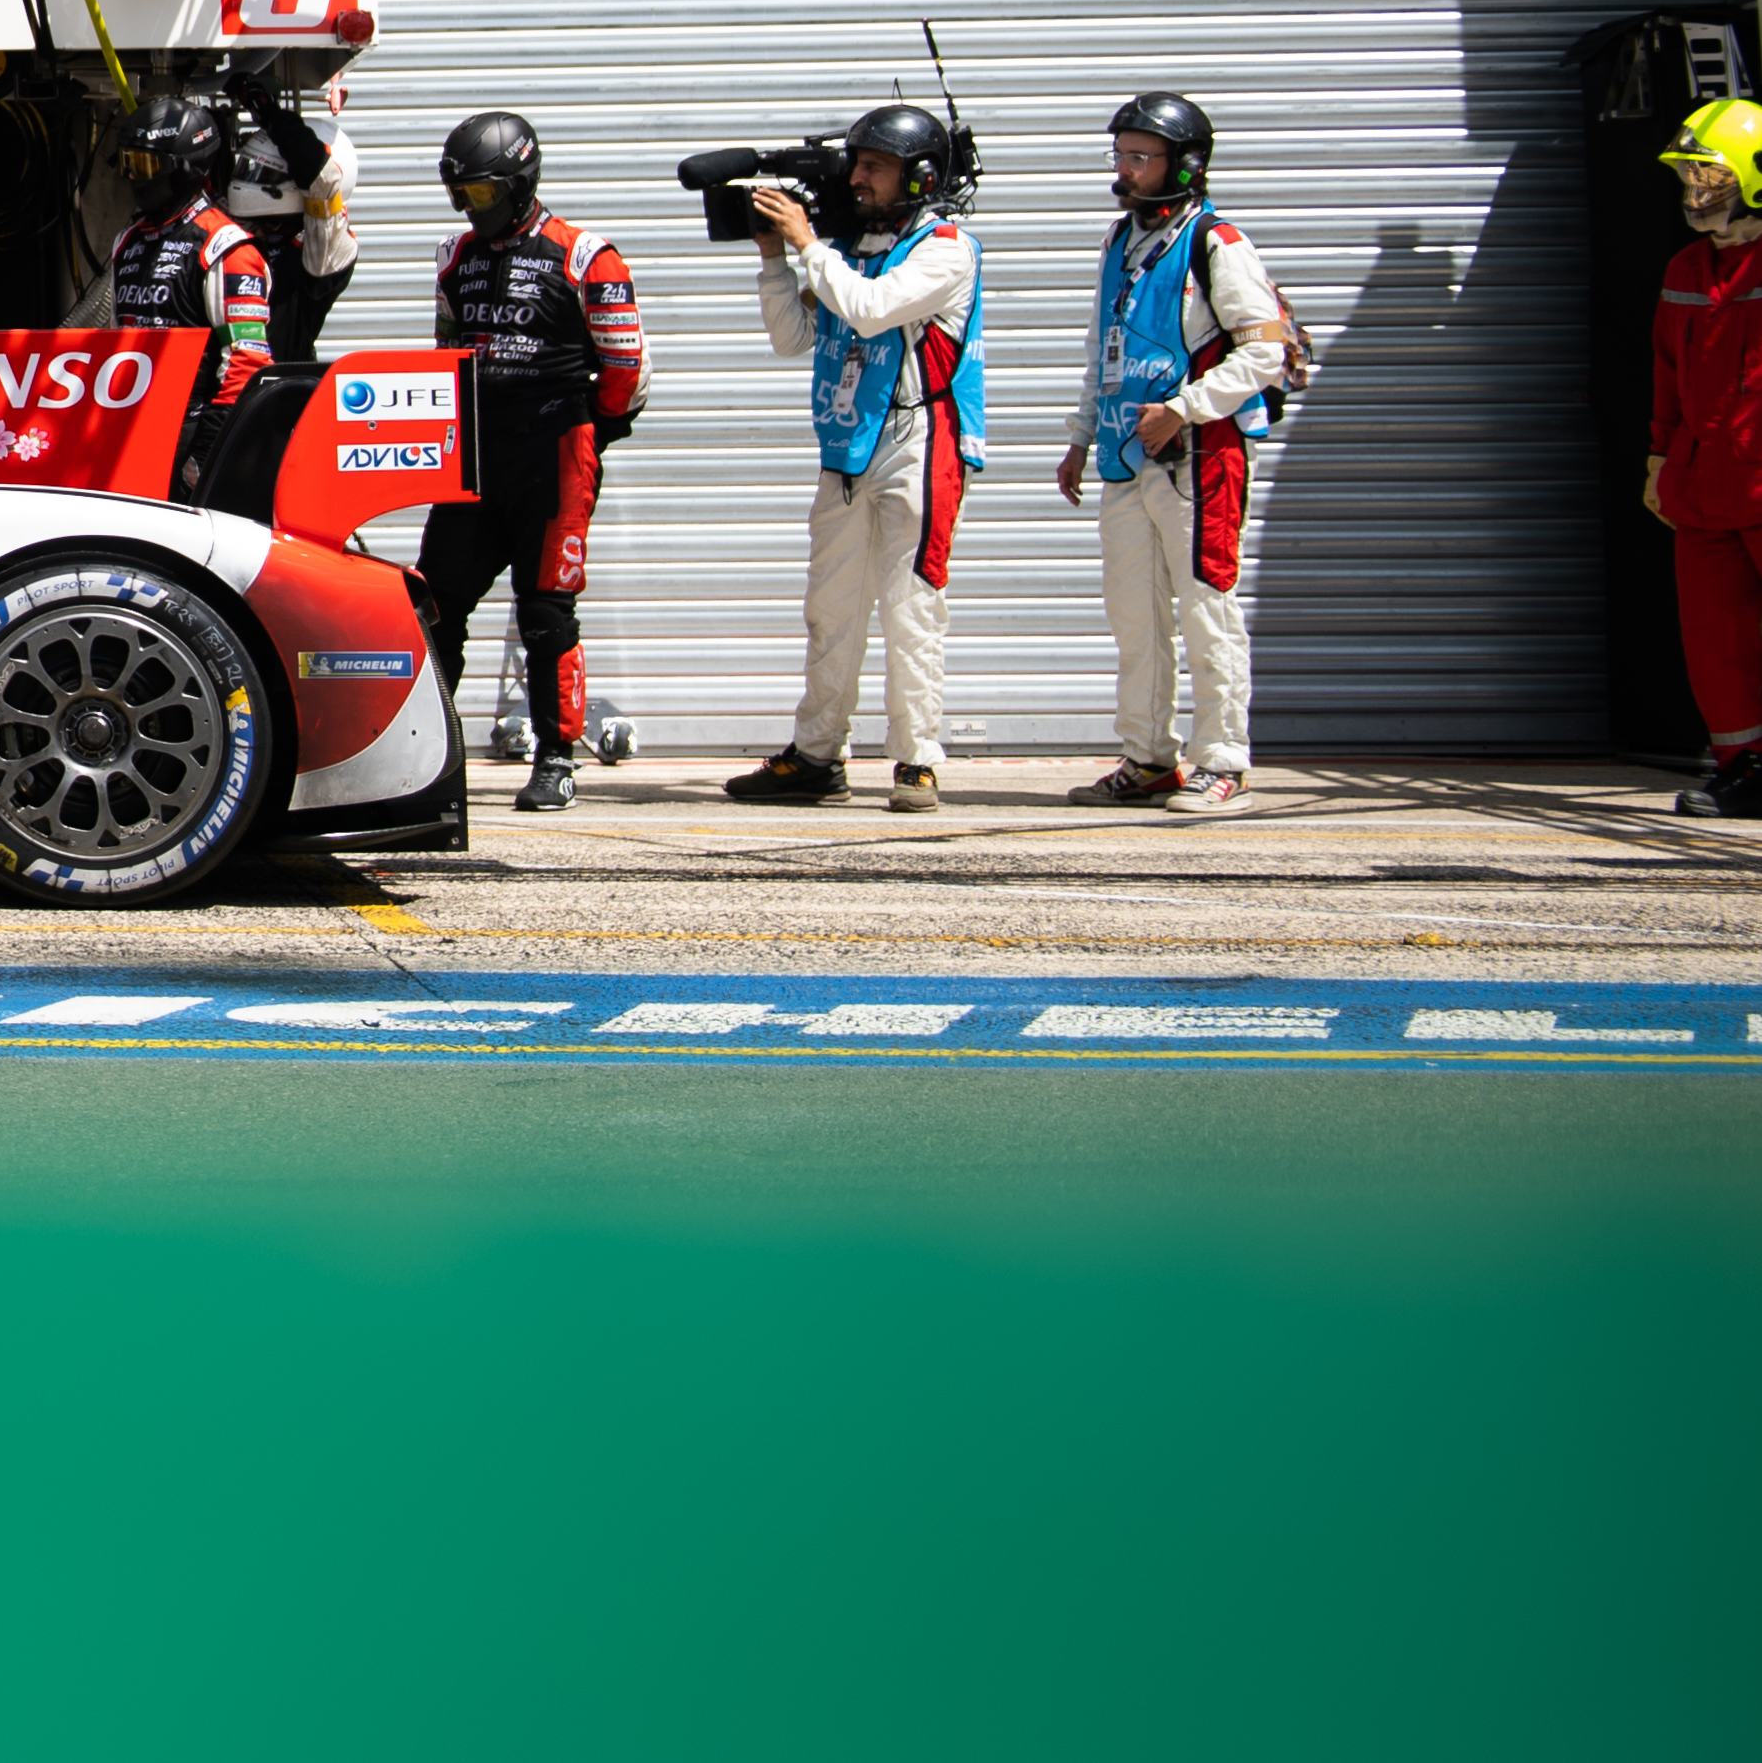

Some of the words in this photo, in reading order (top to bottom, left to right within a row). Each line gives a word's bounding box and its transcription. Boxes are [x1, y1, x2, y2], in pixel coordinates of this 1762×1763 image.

[146, 126, 180, 141] uvex
[504, 135, 528, 159] uvex
[511, 256, 541, 271] Mobil
[509, 269, 539, 282] ZENT
[462, 302, 535, 325] DENSO
[380, 388, 453, 408] JFE
[342, 446, 440, 469] ADVICS
[15, 587, 50, 607] PILOT
[53, 579, 95, 593] SPORT
[332, 658, 403, 671] MICHELIN
[189, 738, 252, 854] MICHELIN
[142, 858, 175, 879] PILOT
[95, 873, 139, 887] SPORT
